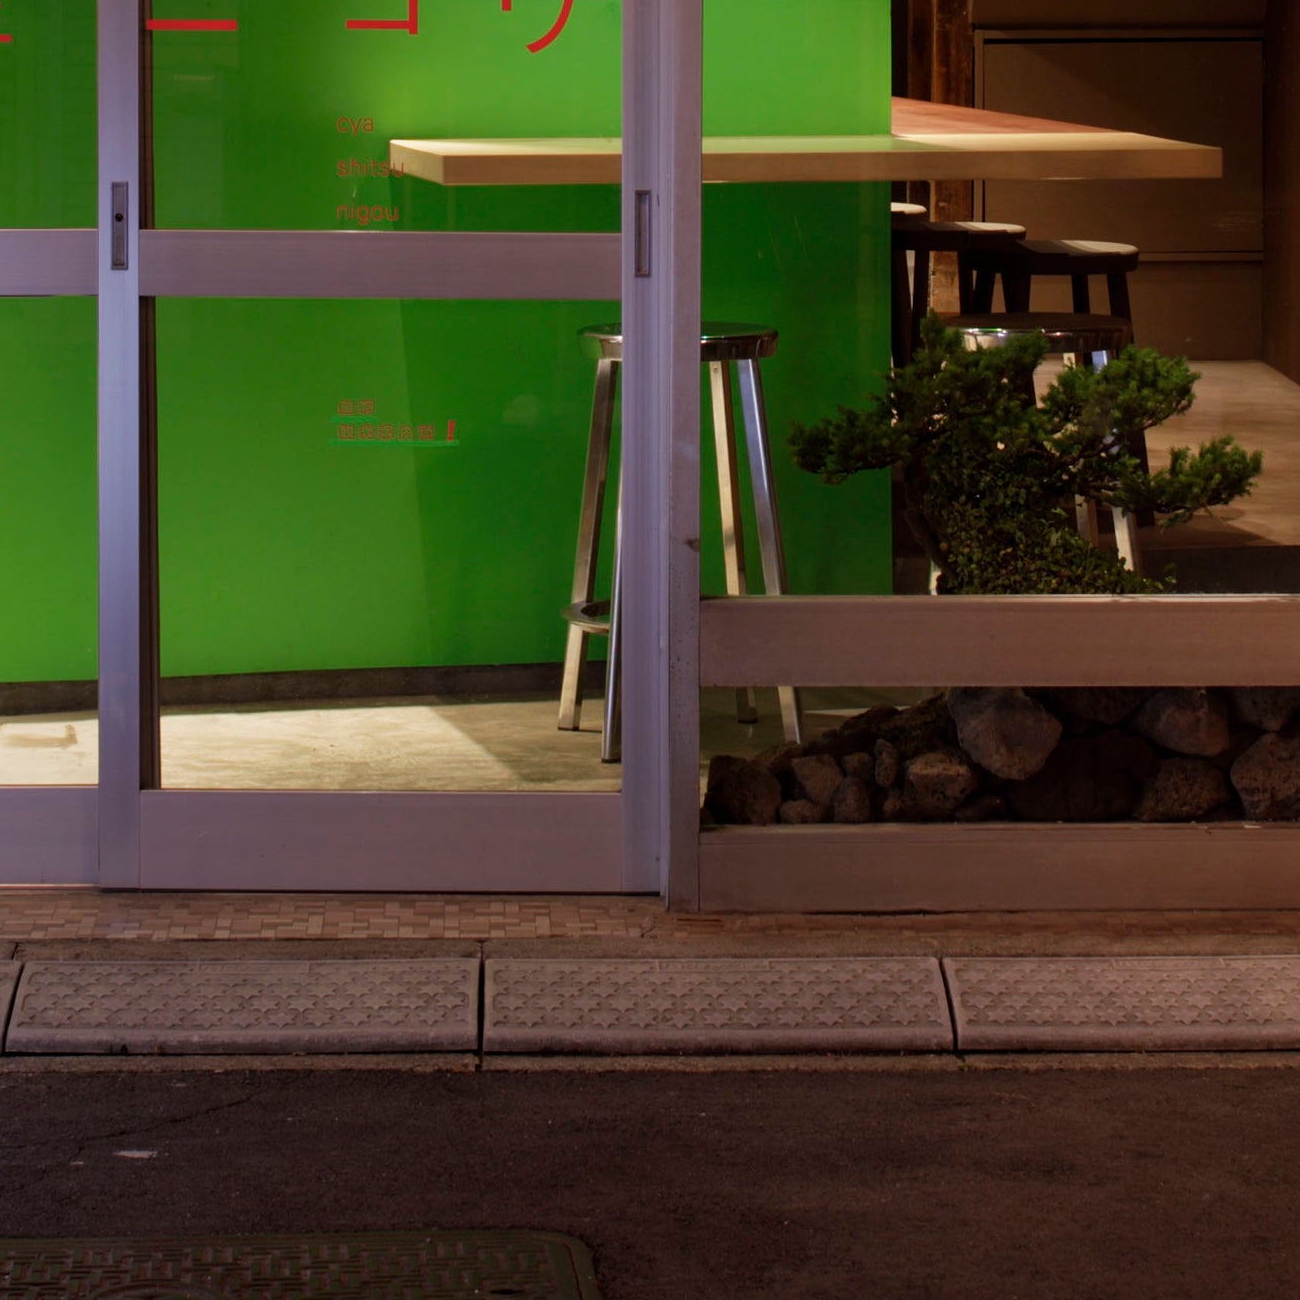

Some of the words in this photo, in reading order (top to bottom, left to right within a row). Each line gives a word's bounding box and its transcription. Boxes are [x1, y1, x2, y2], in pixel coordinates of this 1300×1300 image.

[336, 116, 375, 135] cya
[336, 156, 405, 177] shitsu
[336, 201, 400, 226] nigou
